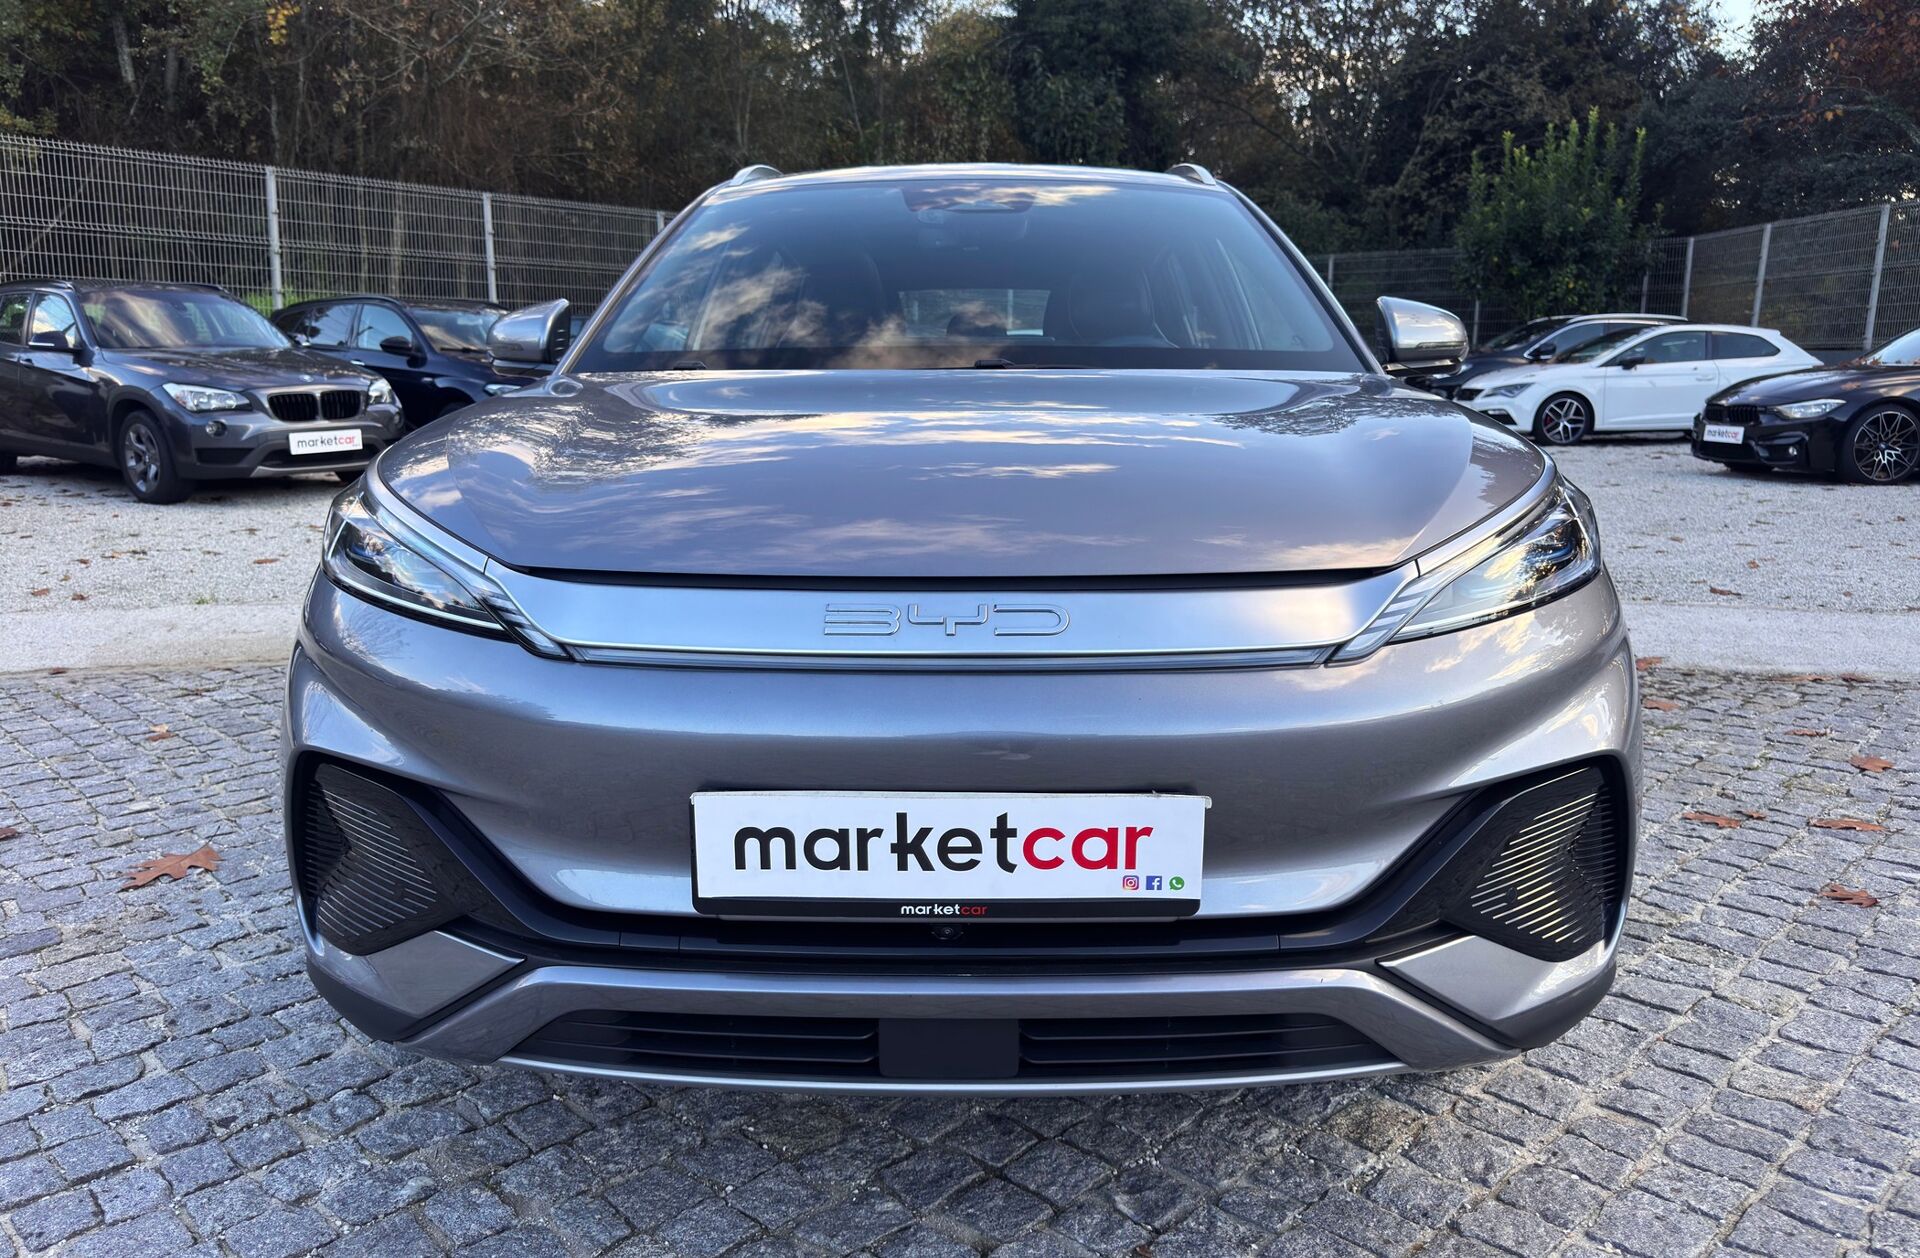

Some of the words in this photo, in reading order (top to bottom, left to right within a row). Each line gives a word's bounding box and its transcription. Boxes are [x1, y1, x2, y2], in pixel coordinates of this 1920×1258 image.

[297, 435, 356, 448] marketcar
[823, 603, 1070, 636] BYD
[733, 811, 1154, 874] marketcar
[900, 903, 988, 915] marketcar
